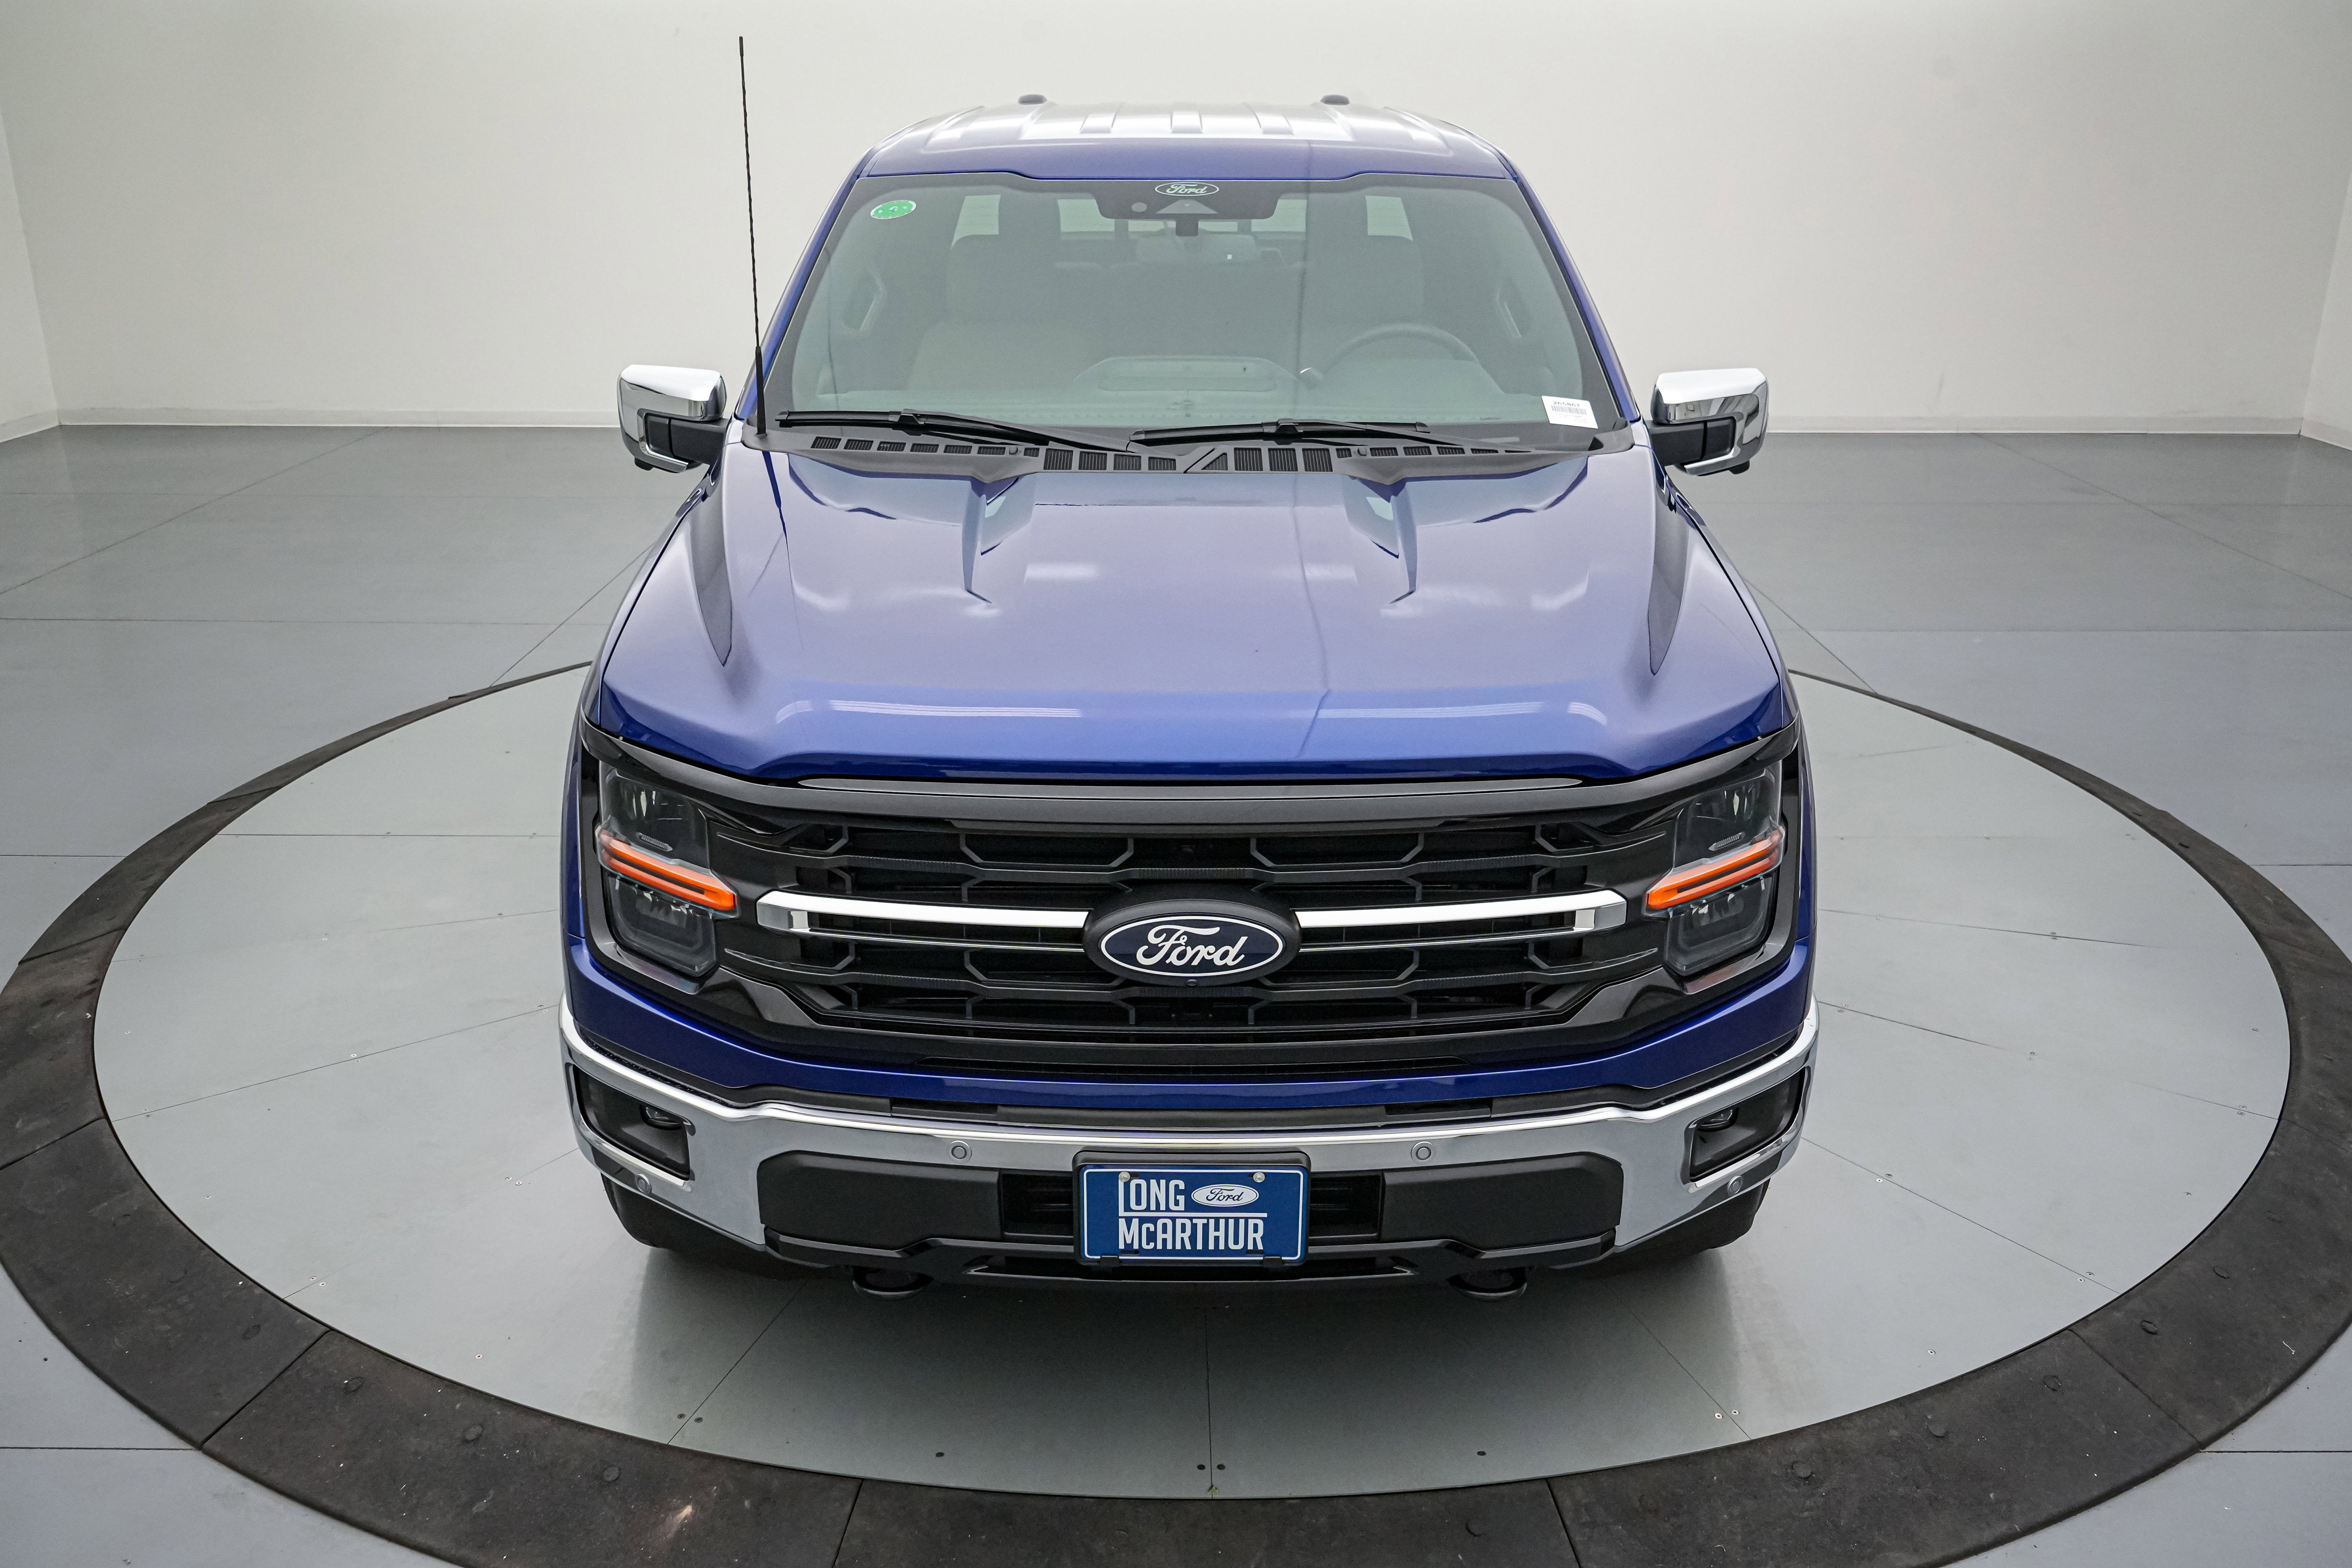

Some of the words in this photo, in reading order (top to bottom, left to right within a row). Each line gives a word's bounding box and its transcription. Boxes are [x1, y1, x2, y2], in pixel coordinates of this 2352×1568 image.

[1166, 184, 1208, 194] Ford
[1136, 925, 1248, 966] Ford
[1118, 1176, 1185, 1217] LONG
[1206, 1188, 1245, 1202] Ford
[1118, 1218, 1264, 1250] McARTHUR
